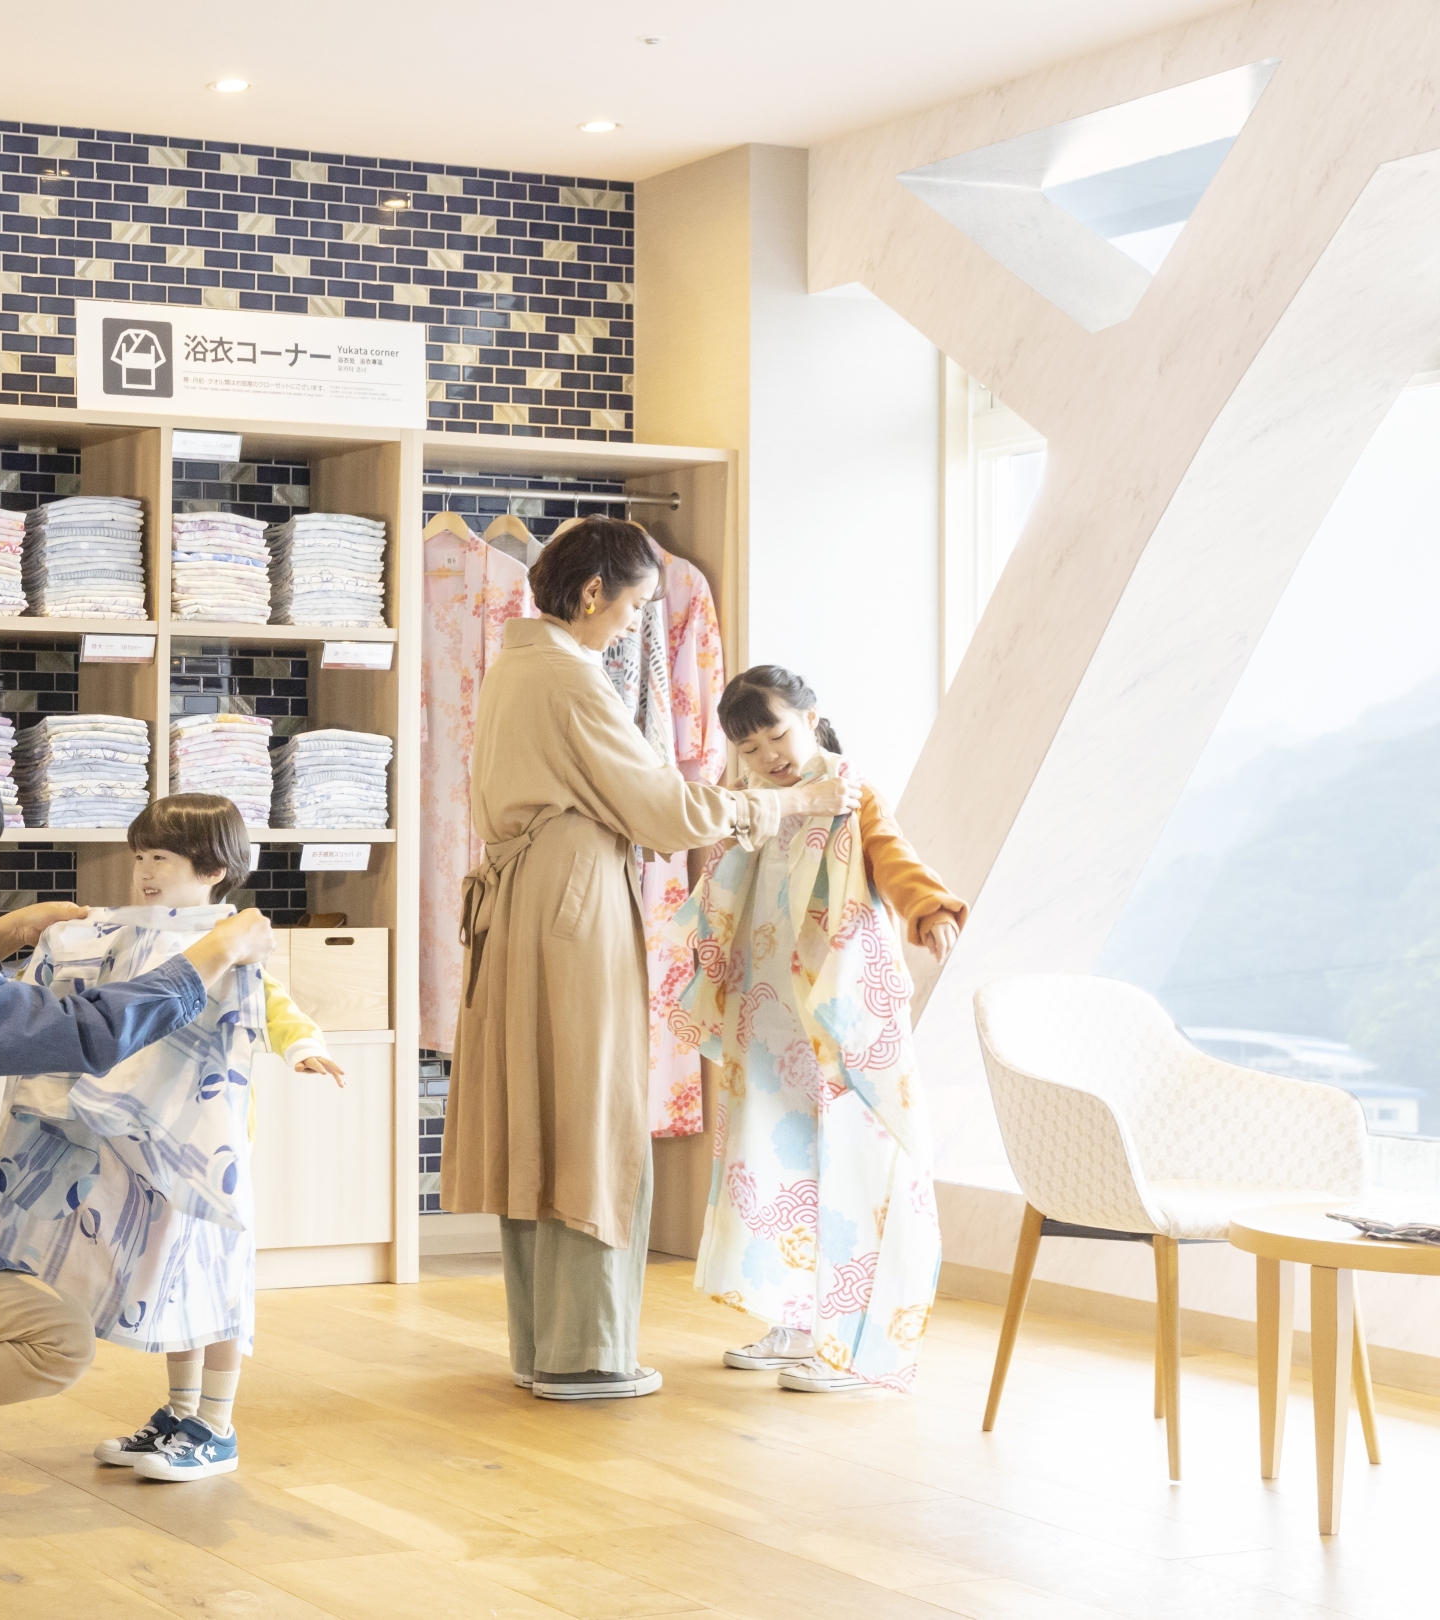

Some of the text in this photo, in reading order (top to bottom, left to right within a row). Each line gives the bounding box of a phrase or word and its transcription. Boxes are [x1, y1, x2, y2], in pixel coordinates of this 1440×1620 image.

[183, 334, 332, 368] 浴衣コーナー
[337, 345, 400, 358] Yukata corner
